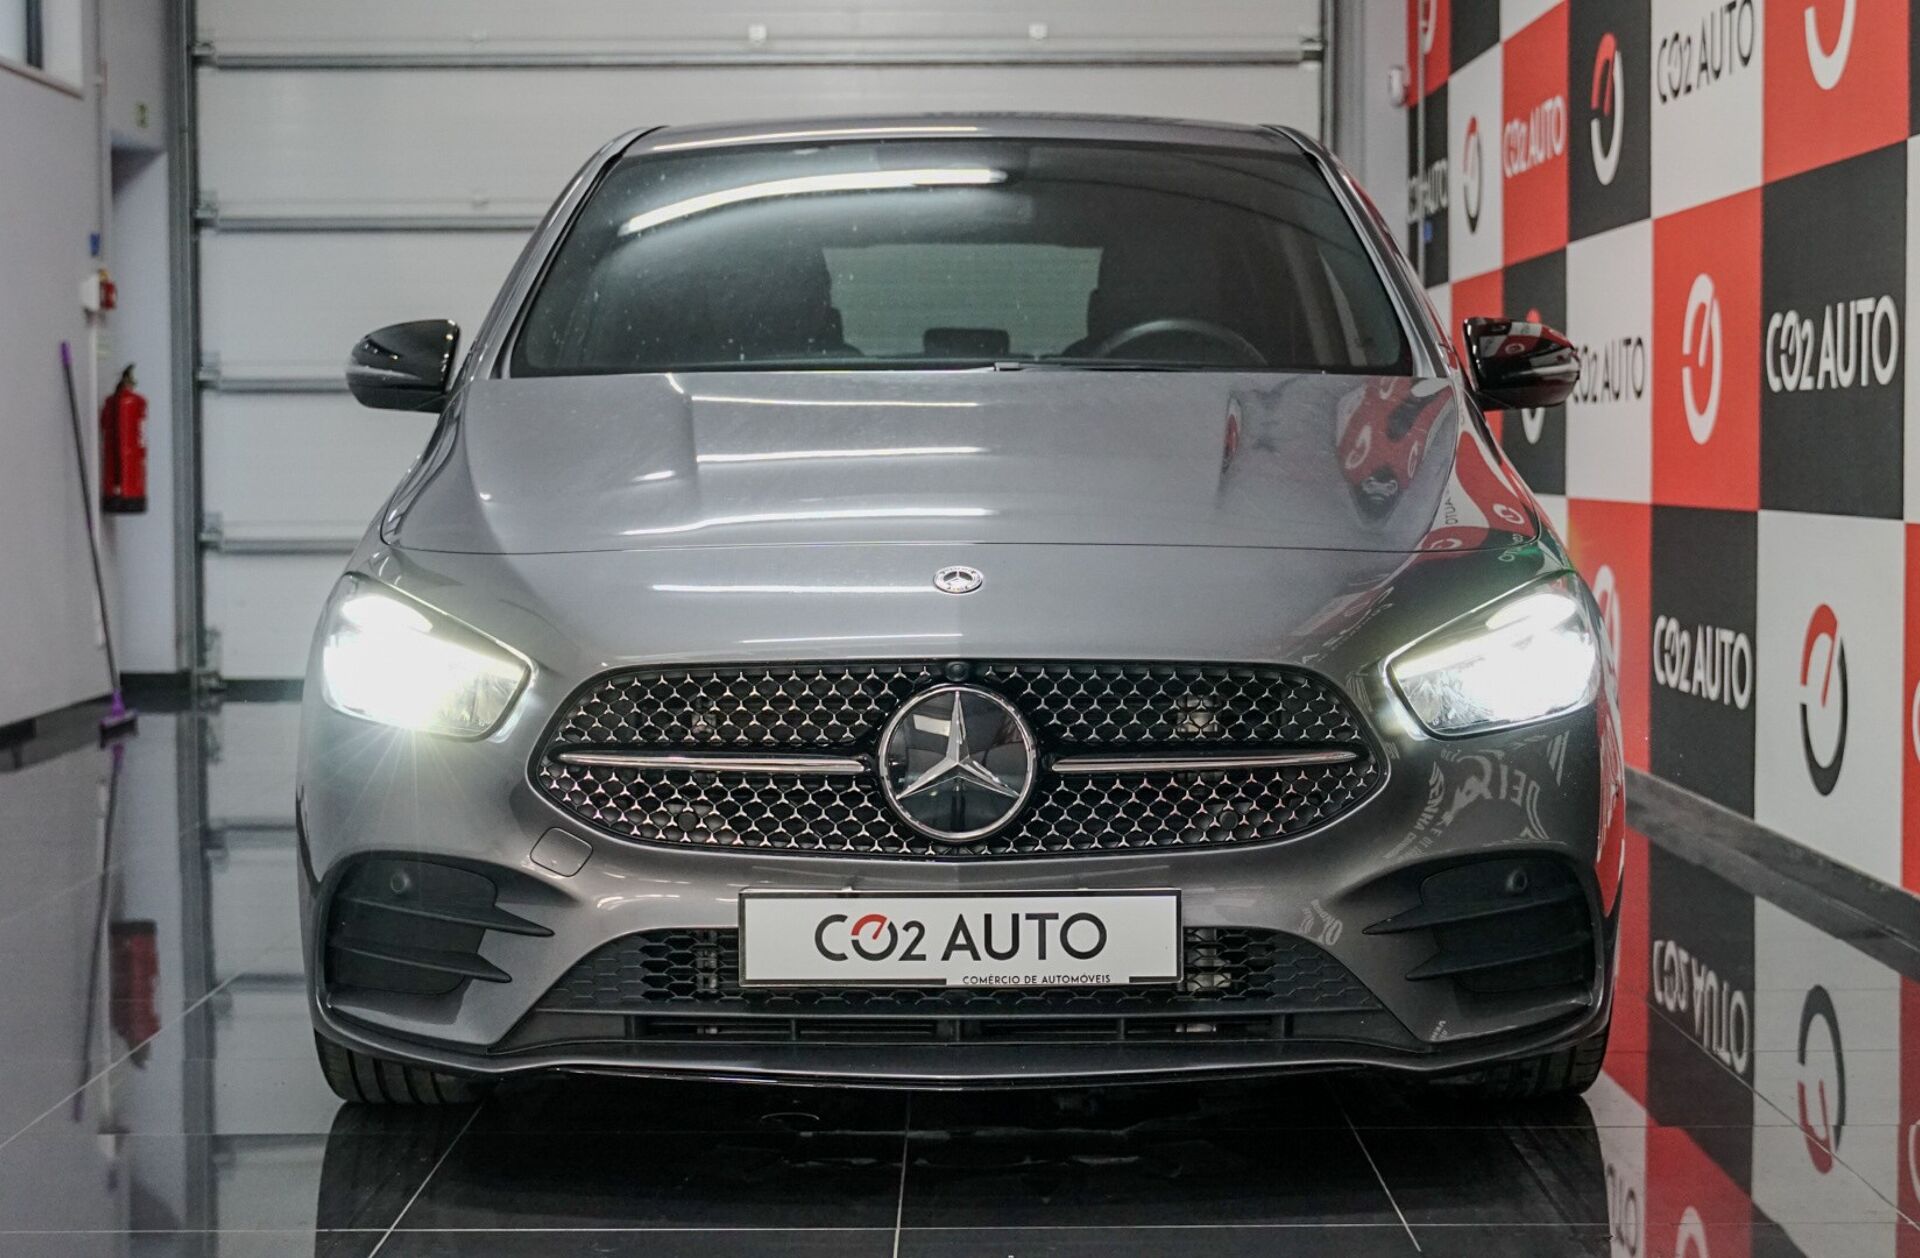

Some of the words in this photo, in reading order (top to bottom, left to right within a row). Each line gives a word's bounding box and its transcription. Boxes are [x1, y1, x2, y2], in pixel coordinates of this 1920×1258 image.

[1657, 32, 1692, 104] CO2
[1696, 0, 1755, 90] AUTO
[1530, 95, 1566, 166] AUTO
[1601, 336, 1645, 403] AUTO
[1767, 310, 1814, 393] CO2
[1817, 295, 1899, 390] AUTO
[1653, 614, 1692, 695] CO2
[1692, 624, 1752, 710] AUTO
[814, 913, 926, 962] CO2
[940, 912, 1107, 962] AUTO
[962, 973, 1021, 985] COMÉRCIO
[1023, 975, 1038, 985] DE
[1042, 972, 1111, 985] AUTOMÓVEIS
